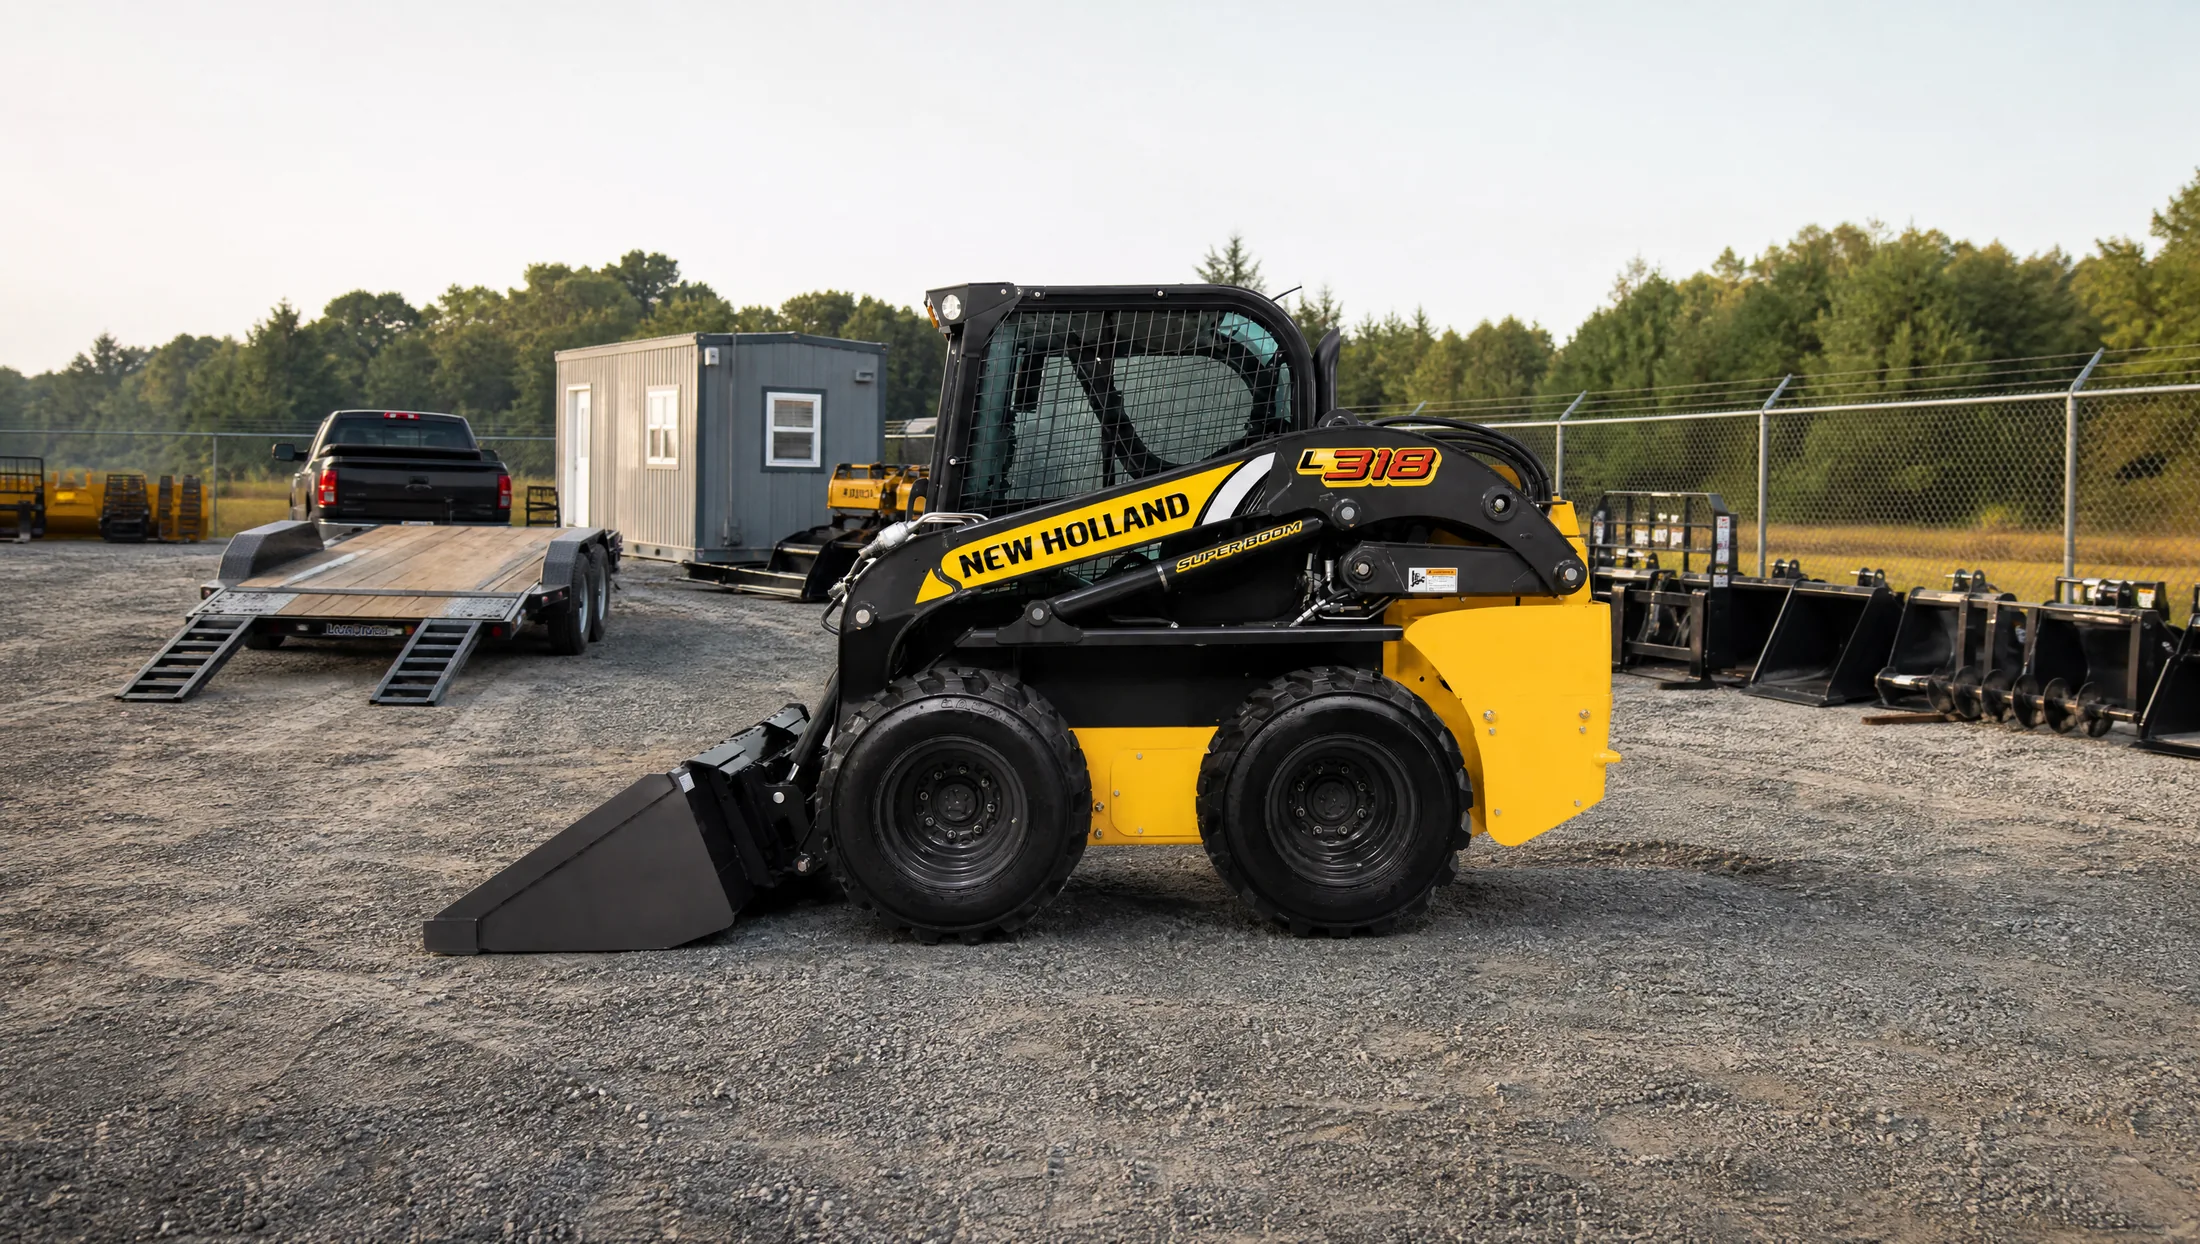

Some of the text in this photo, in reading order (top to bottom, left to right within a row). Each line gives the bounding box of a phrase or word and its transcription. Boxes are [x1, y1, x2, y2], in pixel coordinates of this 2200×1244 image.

[1298, 448, 1439, 484] L318
[959, 493, 1190, 579] NEW HOLLAND
[1176, 520, 1302, 572] SUPER BOOM
